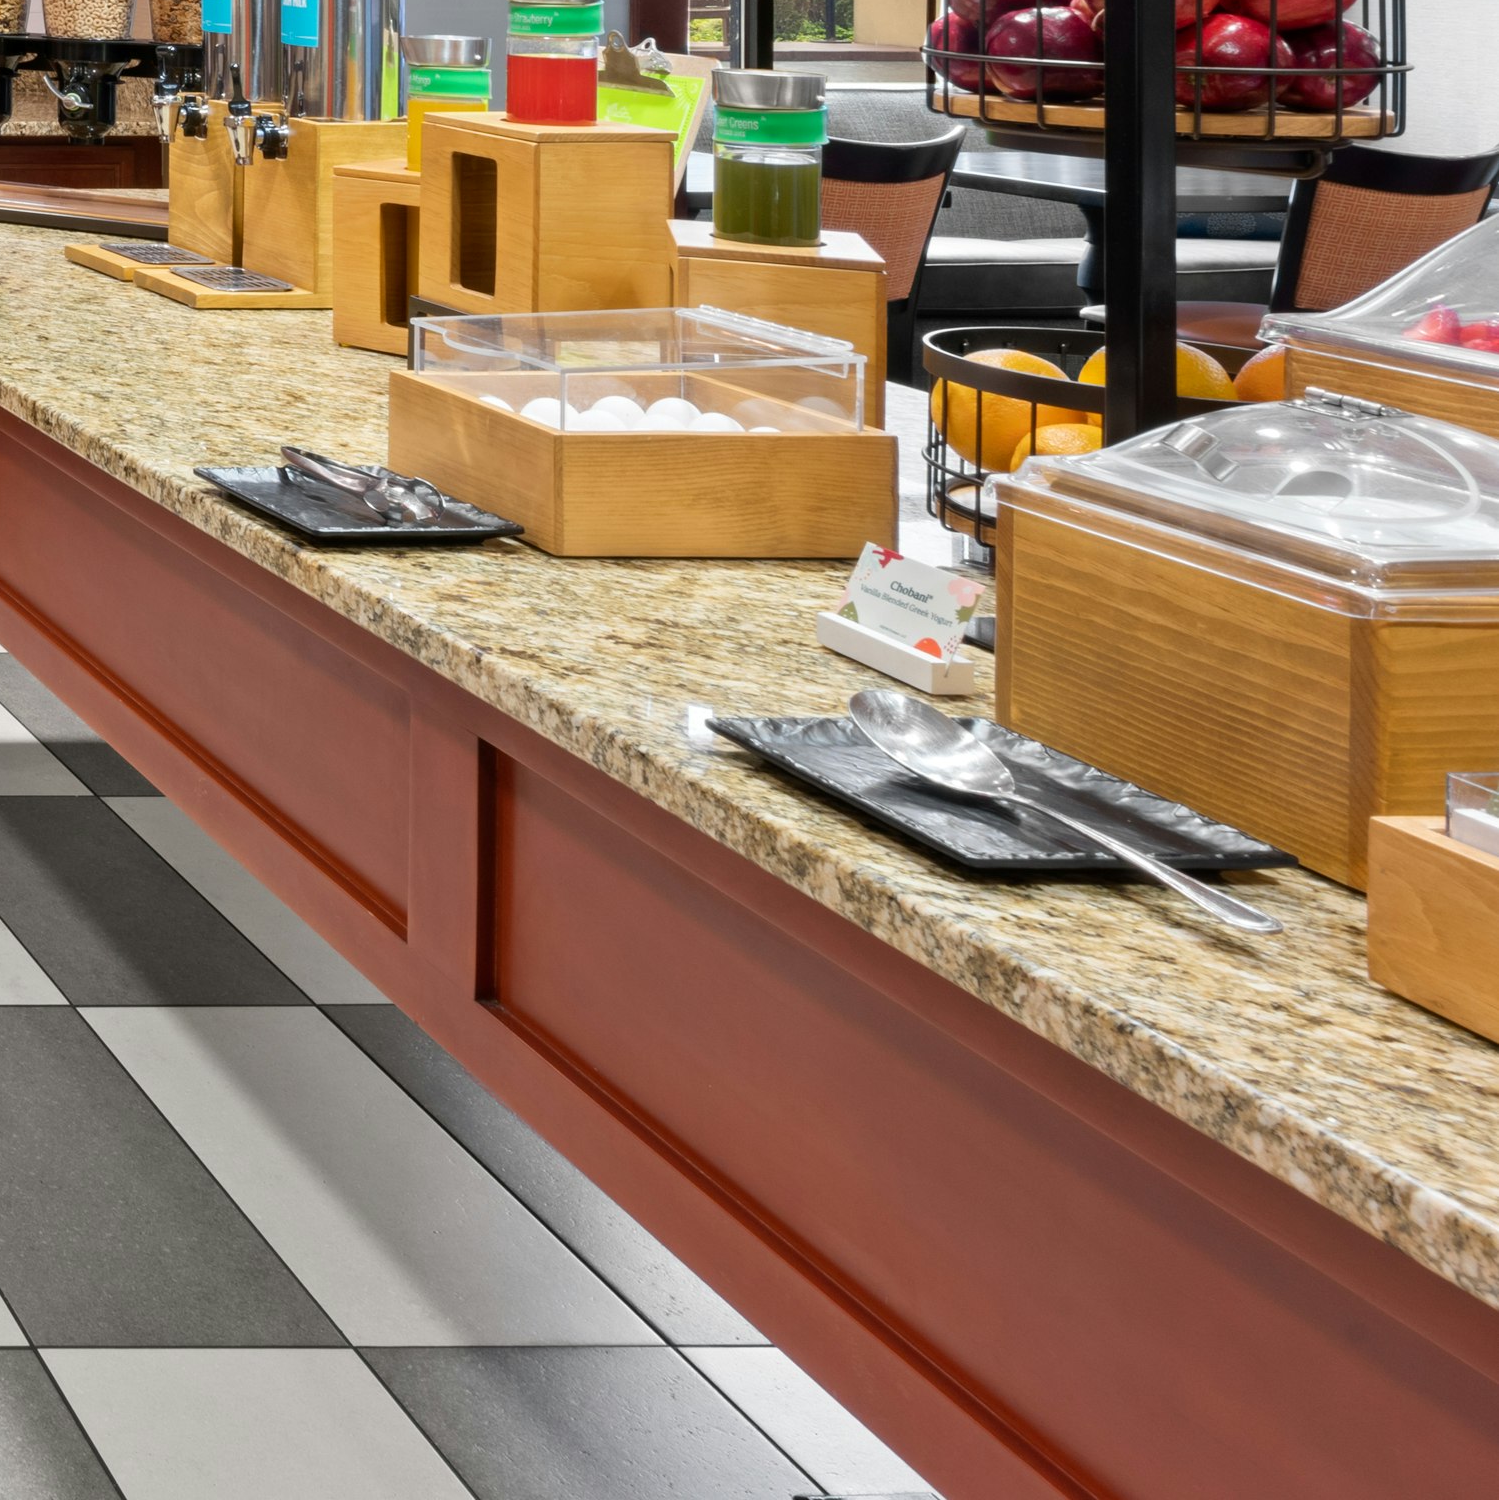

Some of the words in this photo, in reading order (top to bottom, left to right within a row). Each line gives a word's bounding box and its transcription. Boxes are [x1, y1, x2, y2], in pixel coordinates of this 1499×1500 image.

[729, 116, 759, 130] Greens
[860, 583, 881, 598] Vanilla
[881, 591, 908, 610] Blended
[909, 603, 929, 618] Greek
[931, 612, 953, 627] Yogurt
